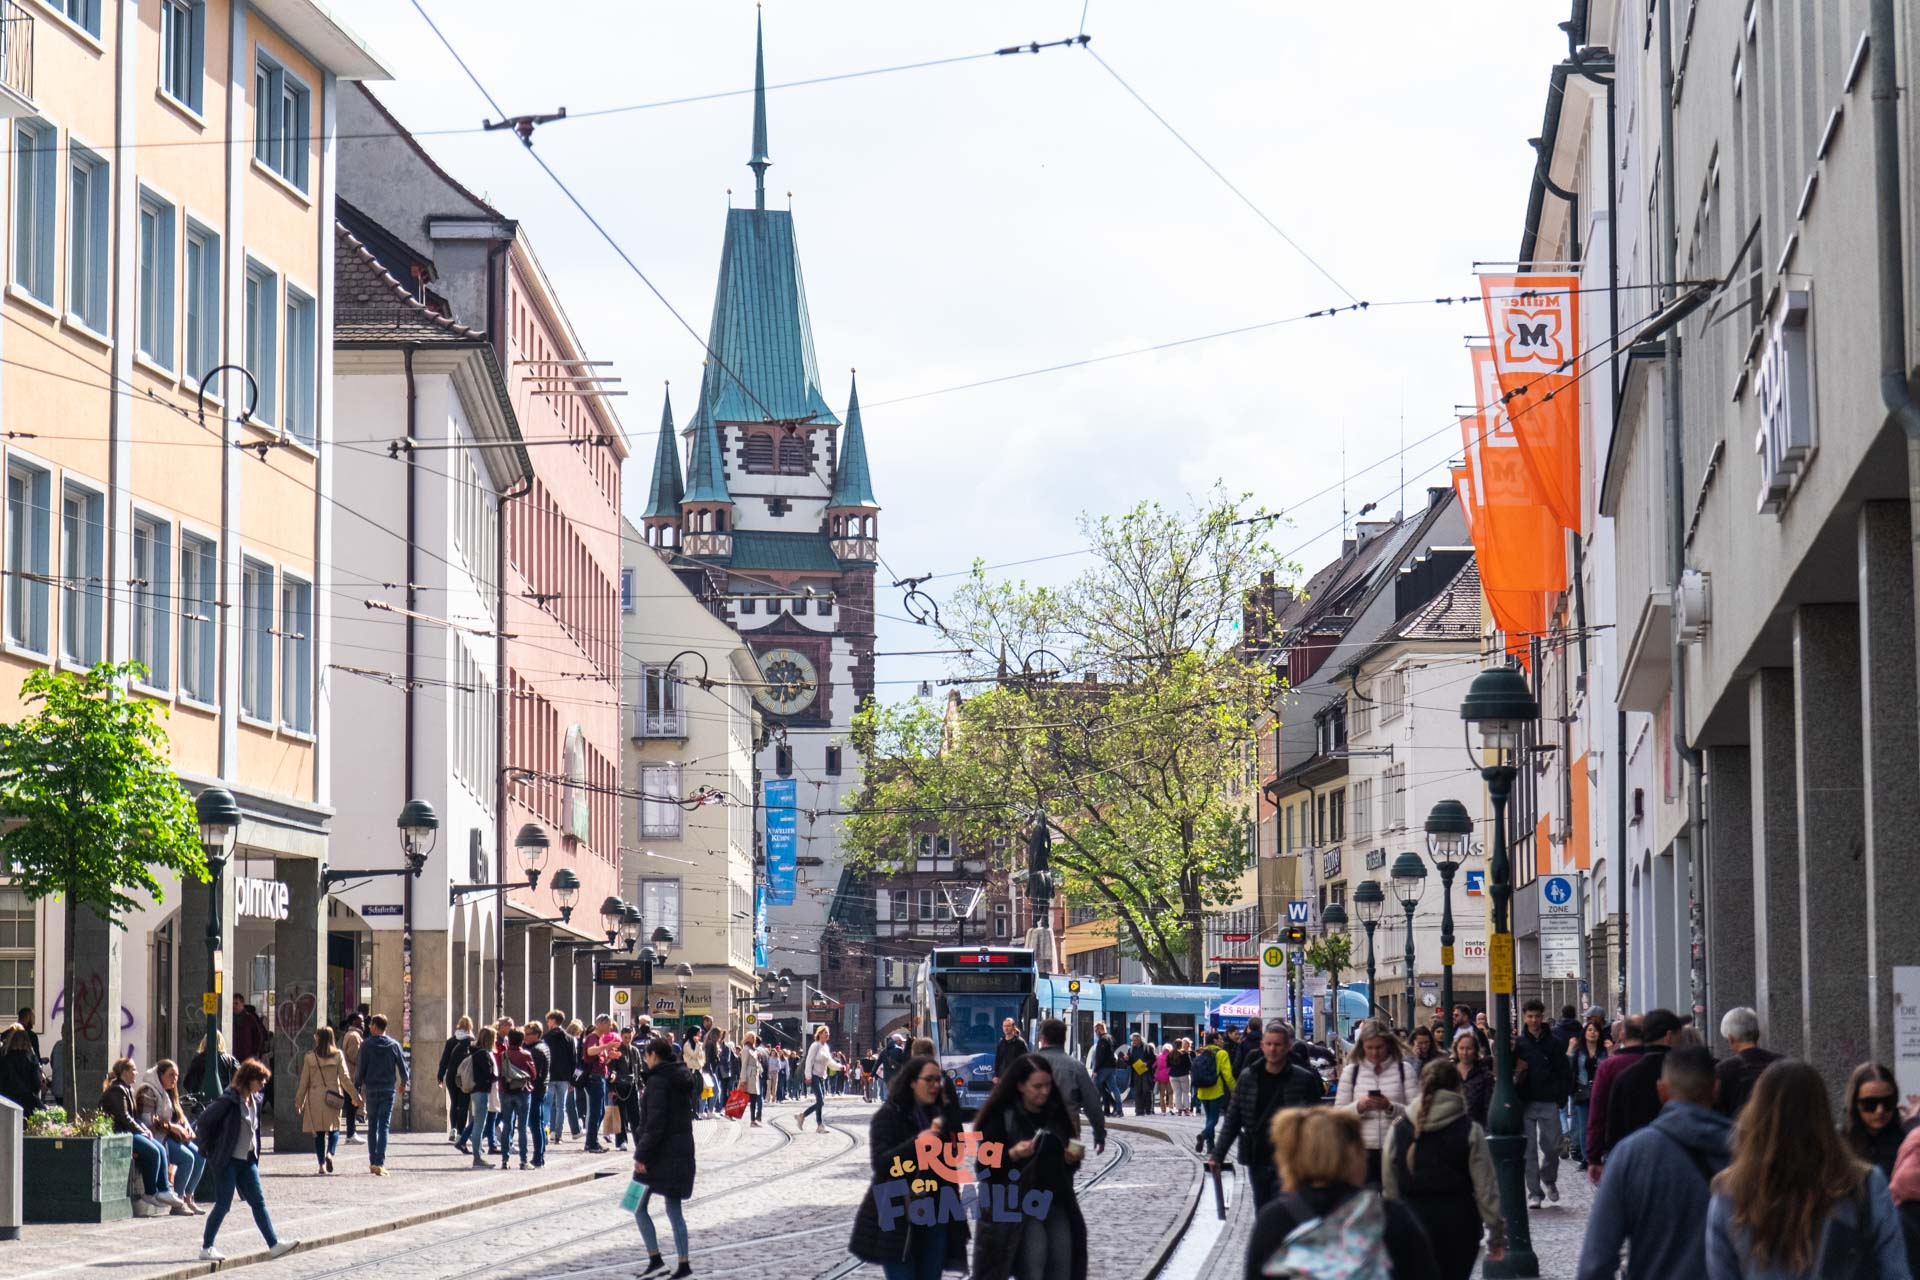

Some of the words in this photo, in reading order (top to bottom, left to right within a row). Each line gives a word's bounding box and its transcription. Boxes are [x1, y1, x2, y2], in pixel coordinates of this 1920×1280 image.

[1517, 323, 1549, 347] M
[234, 876, 289, 926] pimkie
[1288, 903, 1307, 920] W
[656, 998, 674, 1010] dm
[685, 993, 711, 1004] Markt
[1237, 1007, 1259, 1015] REIC
